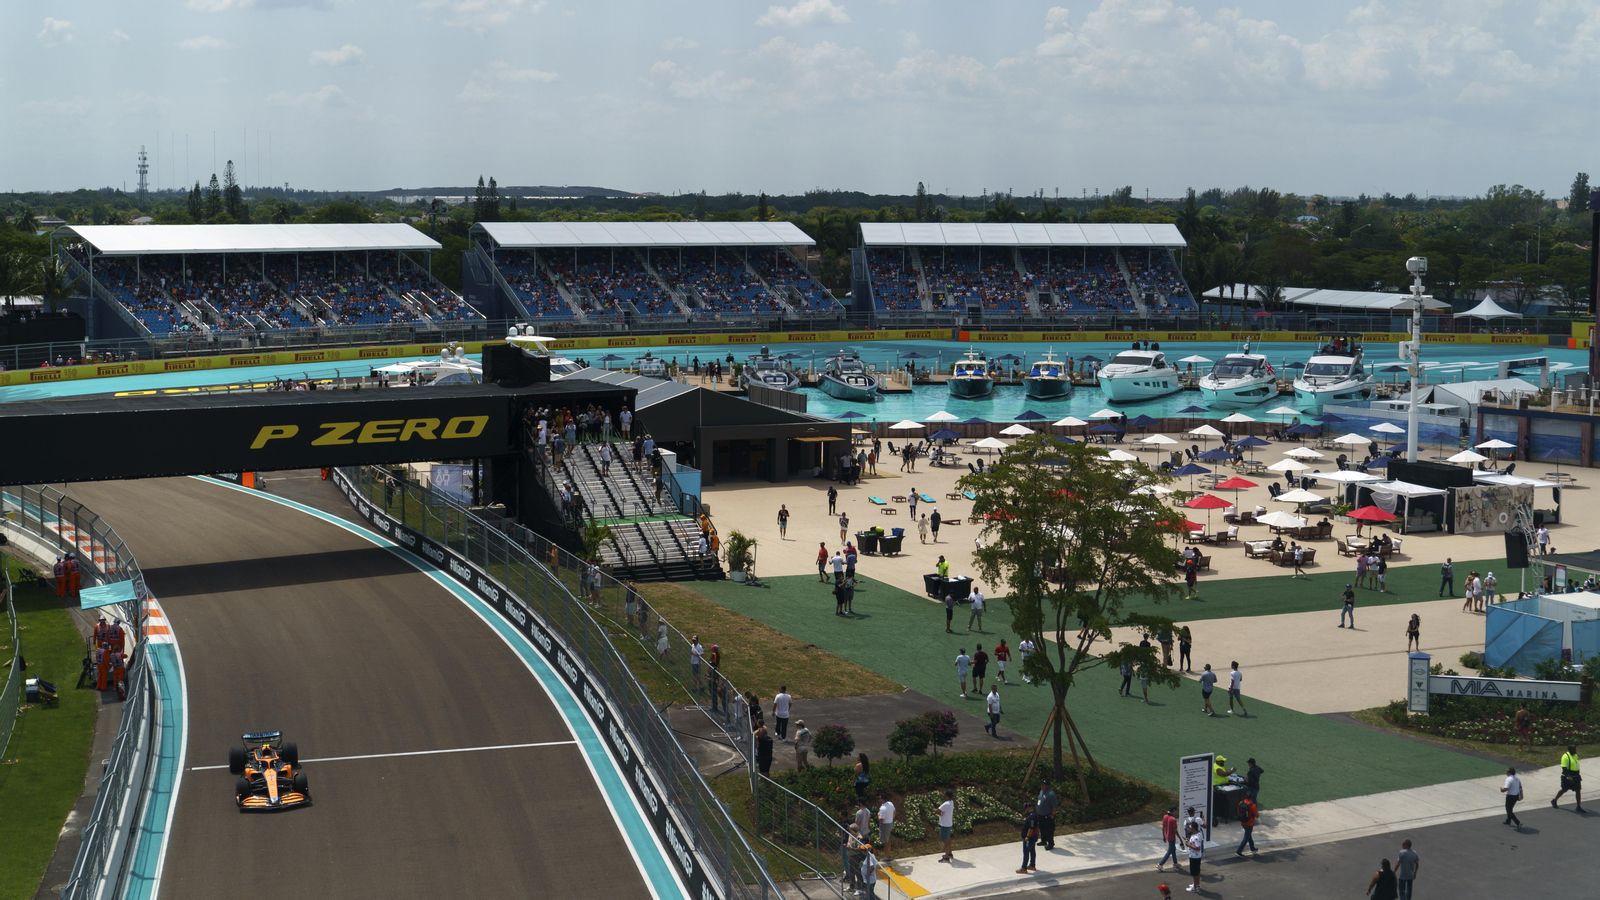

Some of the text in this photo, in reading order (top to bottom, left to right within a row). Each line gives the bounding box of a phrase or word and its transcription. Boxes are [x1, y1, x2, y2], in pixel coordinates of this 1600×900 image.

[250, 415, 489, 449] P ZERO
[1451, 679, 1558, 699] MIA MARINA
